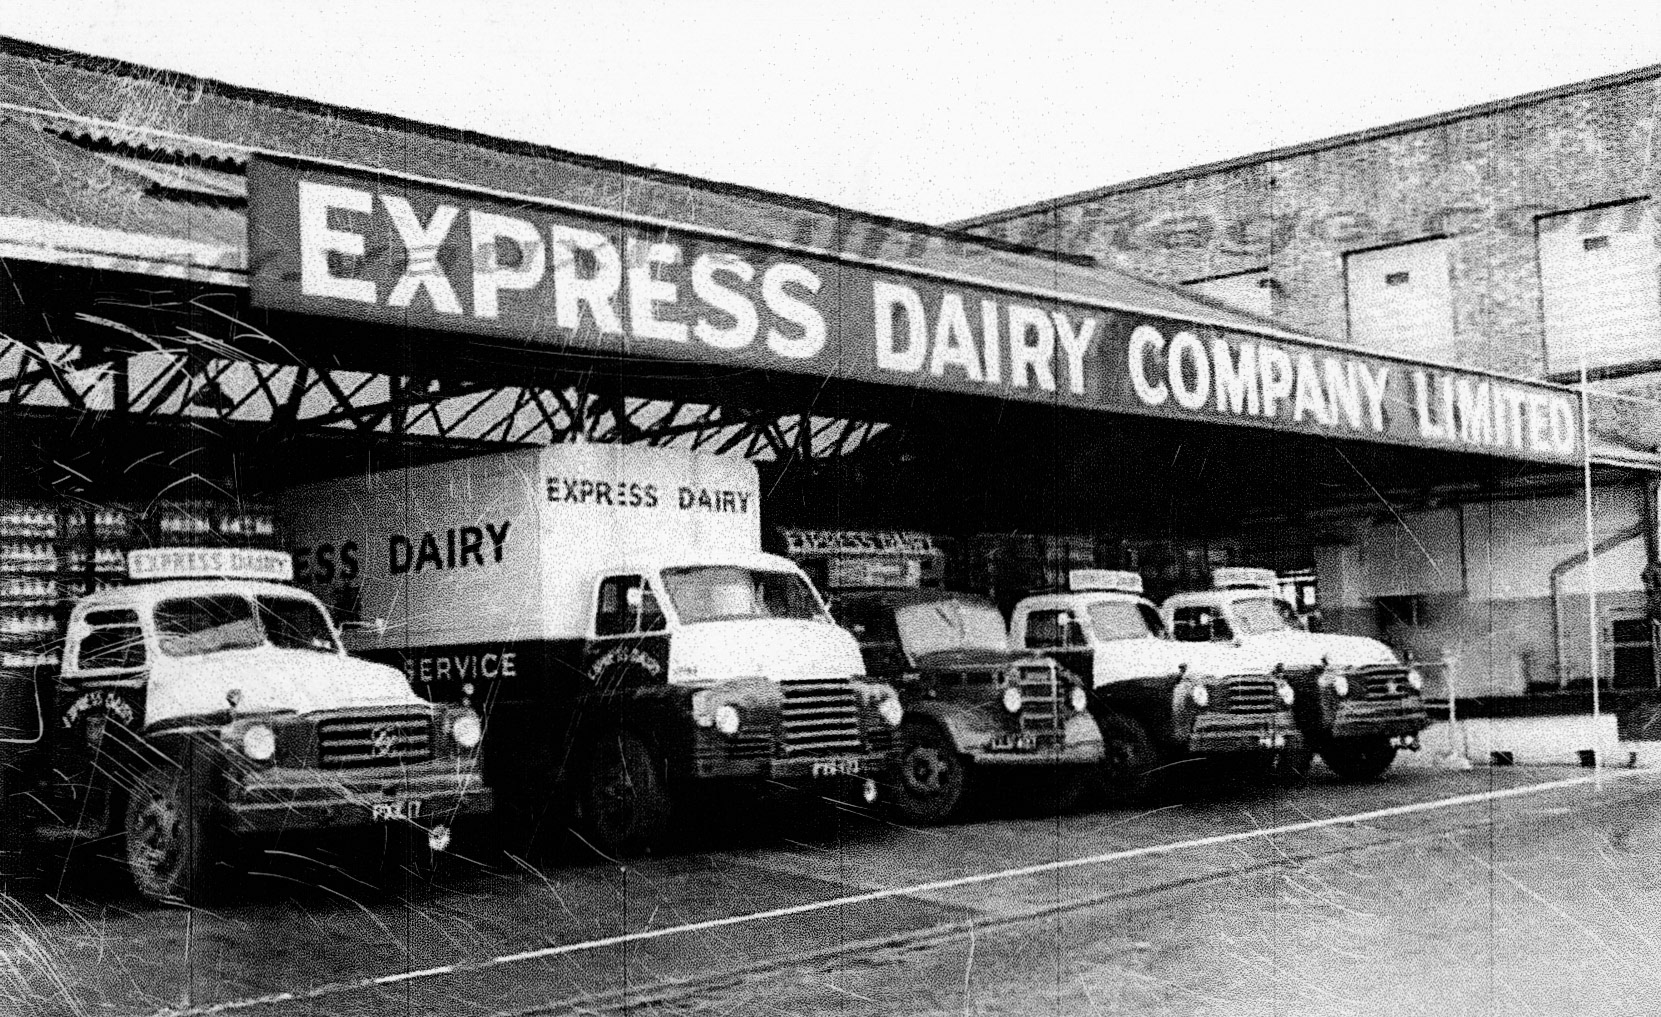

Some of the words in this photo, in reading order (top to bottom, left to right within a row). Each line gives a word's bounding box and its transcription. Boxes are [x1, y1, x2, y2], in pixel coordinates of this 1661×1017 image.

[300, 180, 826, 359] EXPRESS
[872, 281, 1098, 396] DAIRY
[1127, 324, 1391, 433] COMPANY
[1413, 369, 1576, 456] LIMITED
[546, 476, 658, 508] EXPRESS
[678, 485, 751, 514] DAIRY
[294, 538, 360, 585] ESS
[388, 521, 511, 575] DAIRY
[403, 652, 517, 684] SERVICE
